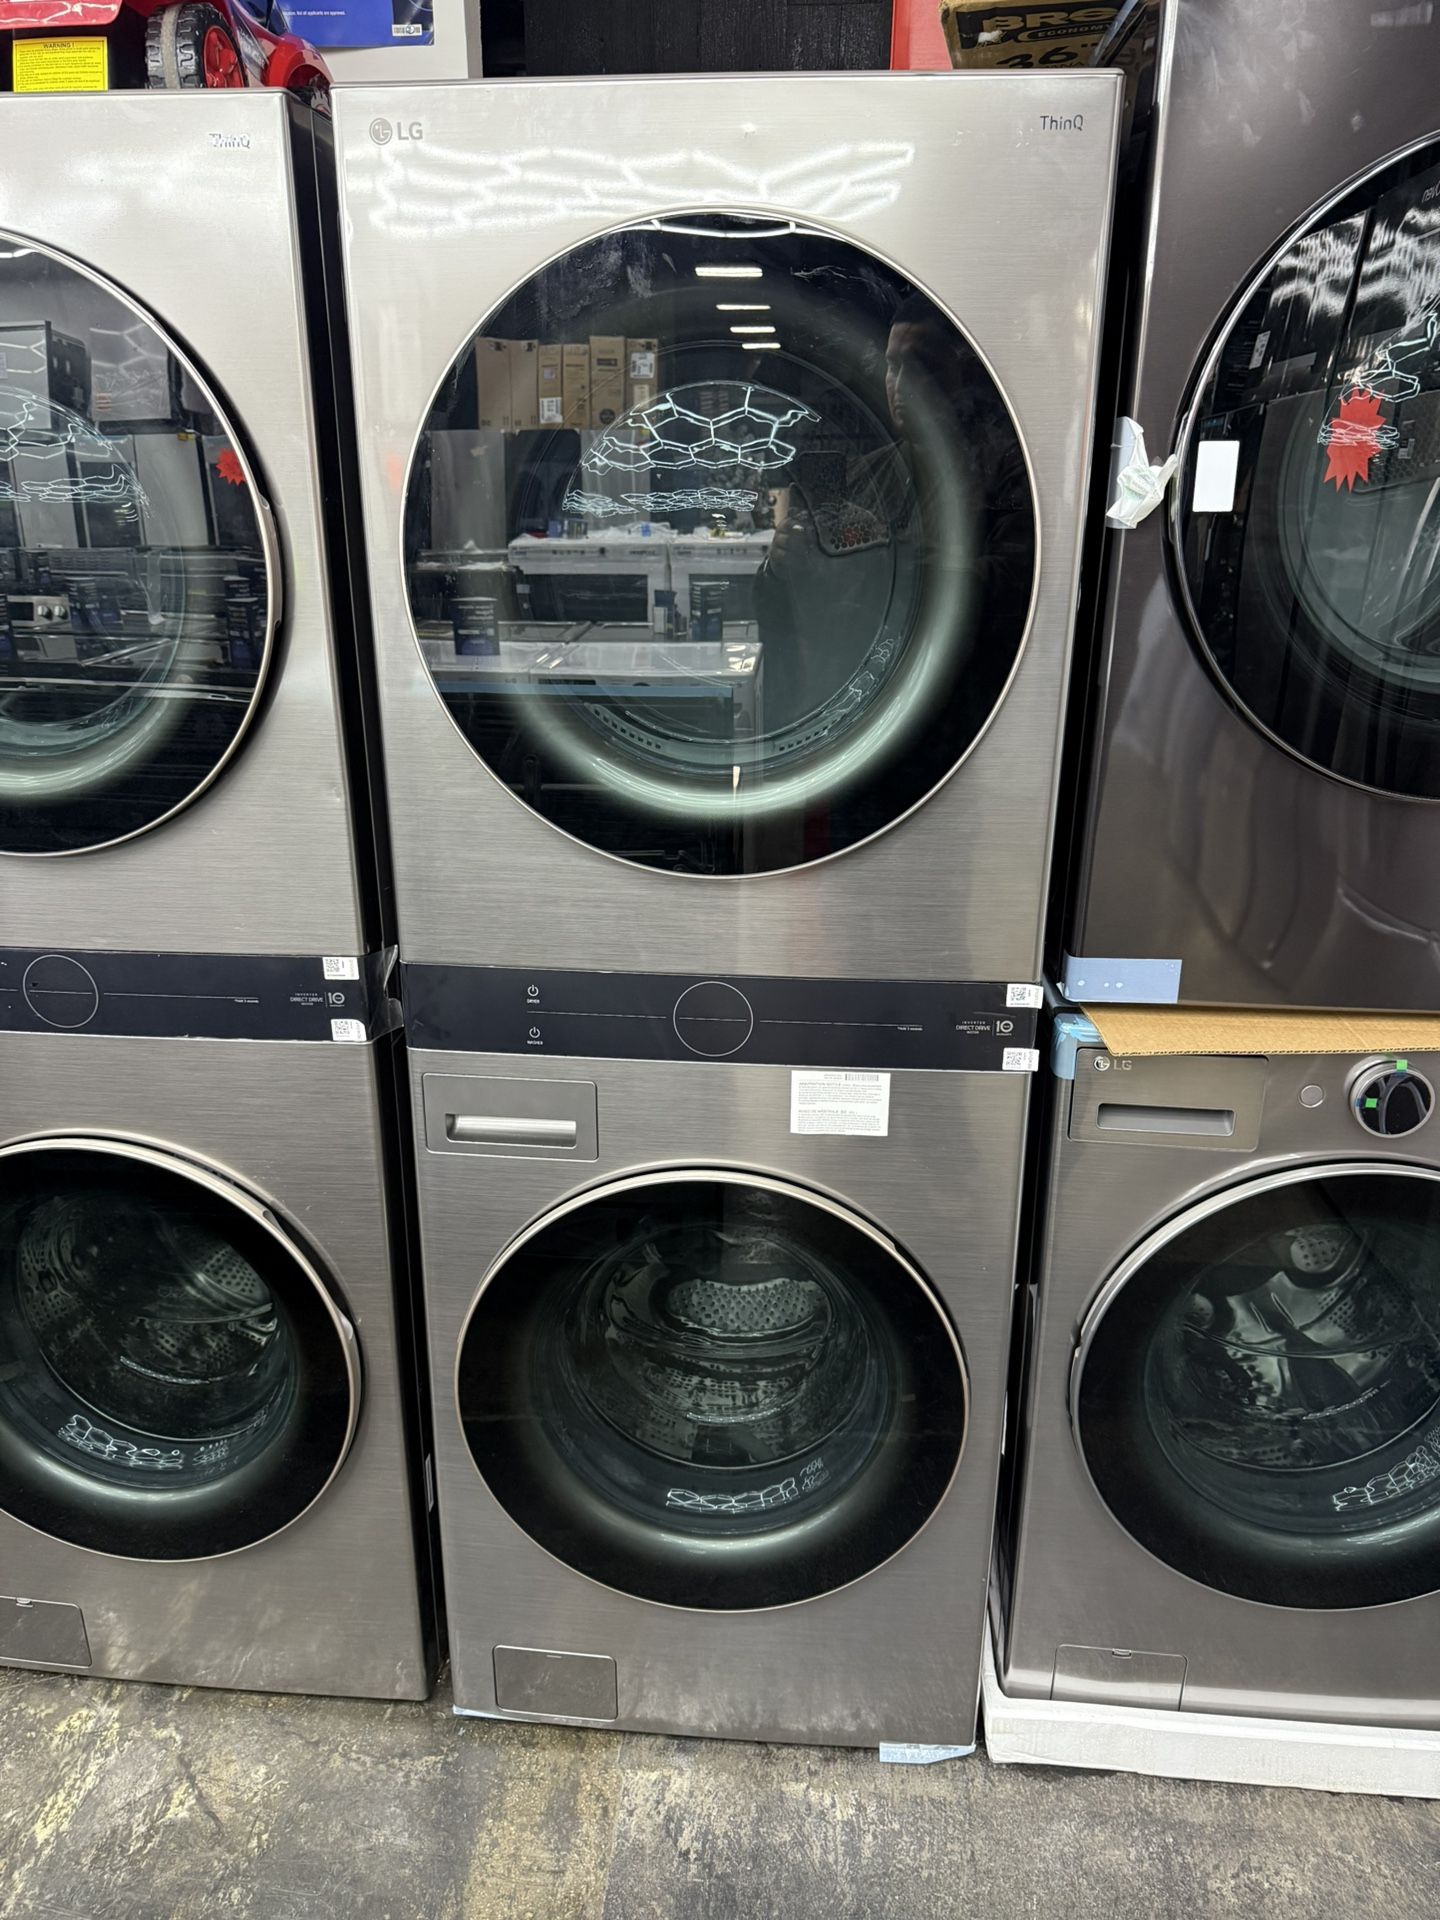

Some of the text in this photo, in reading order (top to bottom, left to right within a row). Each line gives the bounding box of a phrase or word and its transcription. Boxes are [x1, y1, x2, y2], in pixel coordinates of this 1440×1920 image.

[397, 121, 423, 140] LG
[1040, 114, 1084, 132] ThinQ
[1113, 1060, 1133, 1071] LG
